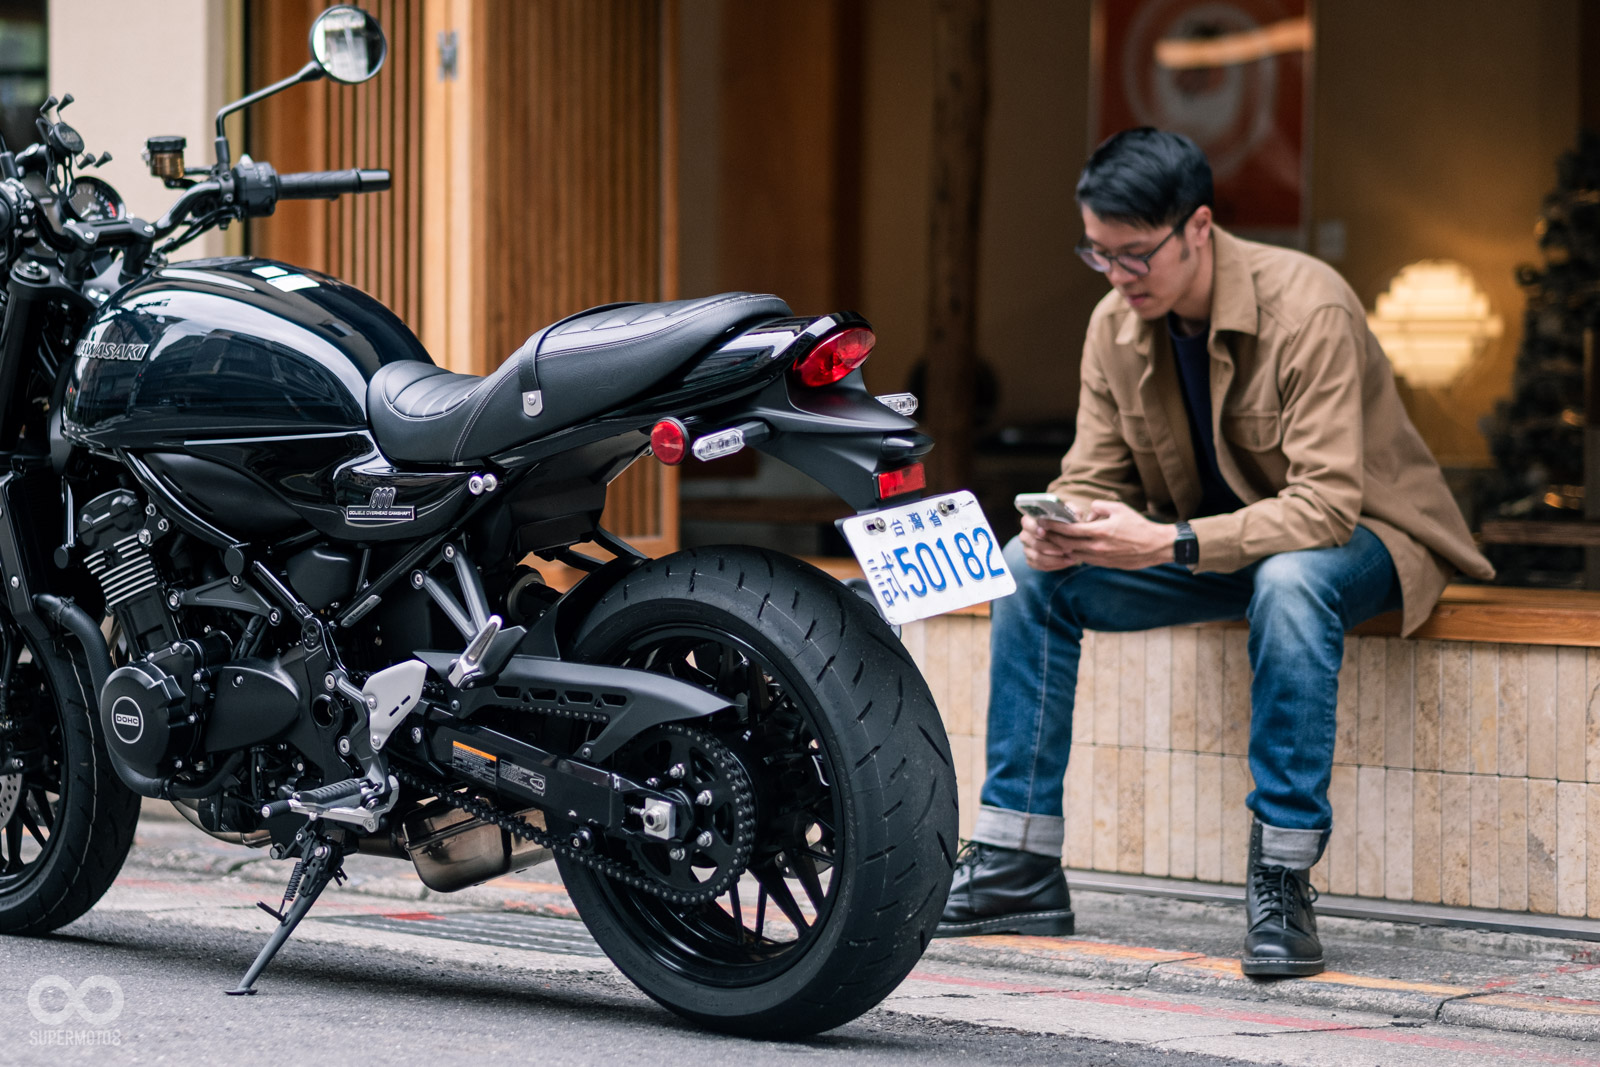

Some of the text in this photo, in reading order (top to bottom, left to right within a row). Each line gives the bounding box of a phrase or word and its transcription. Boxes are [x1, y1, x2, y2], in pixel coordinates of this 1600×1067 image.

[889, 507, 943, 538] 台灣省
[892, 525, 1007, 599] 50182
[116, 715, 139, 725] DOHC
